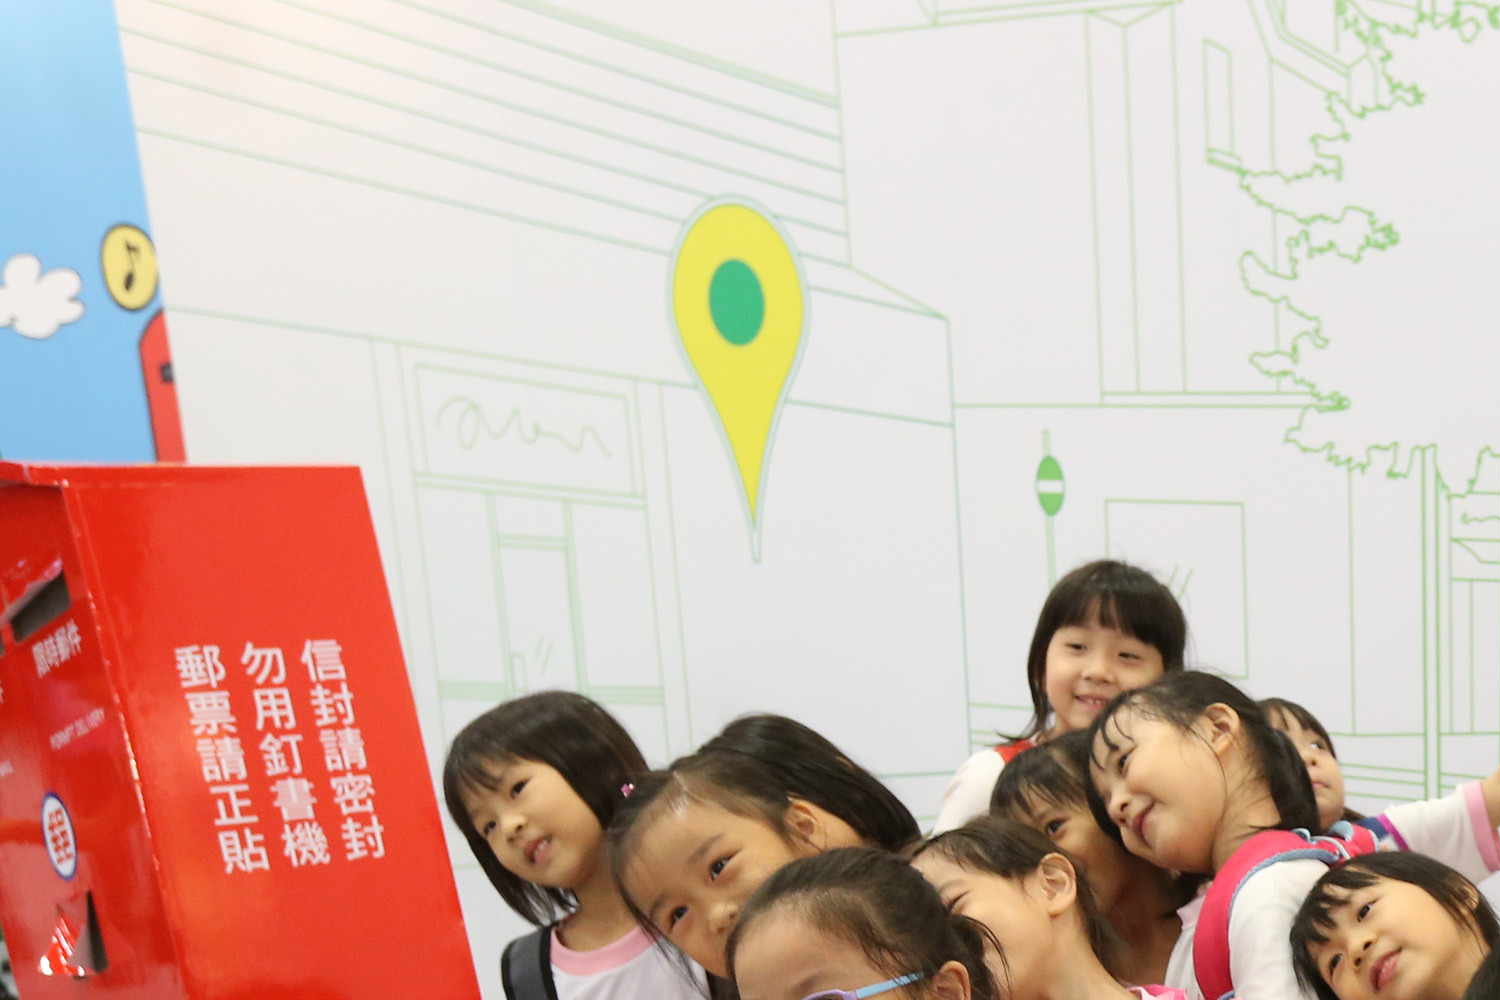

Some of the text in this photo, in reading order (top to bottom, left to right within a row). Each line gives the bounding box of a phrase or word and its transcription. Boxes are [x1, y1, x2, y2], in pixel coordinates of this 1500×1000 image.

[174, 643, 270, 874] 郵票請正貼
[240, 642, 331, 868] 勿用釘書機
[300, 639, 386, 863] 信封請密封
